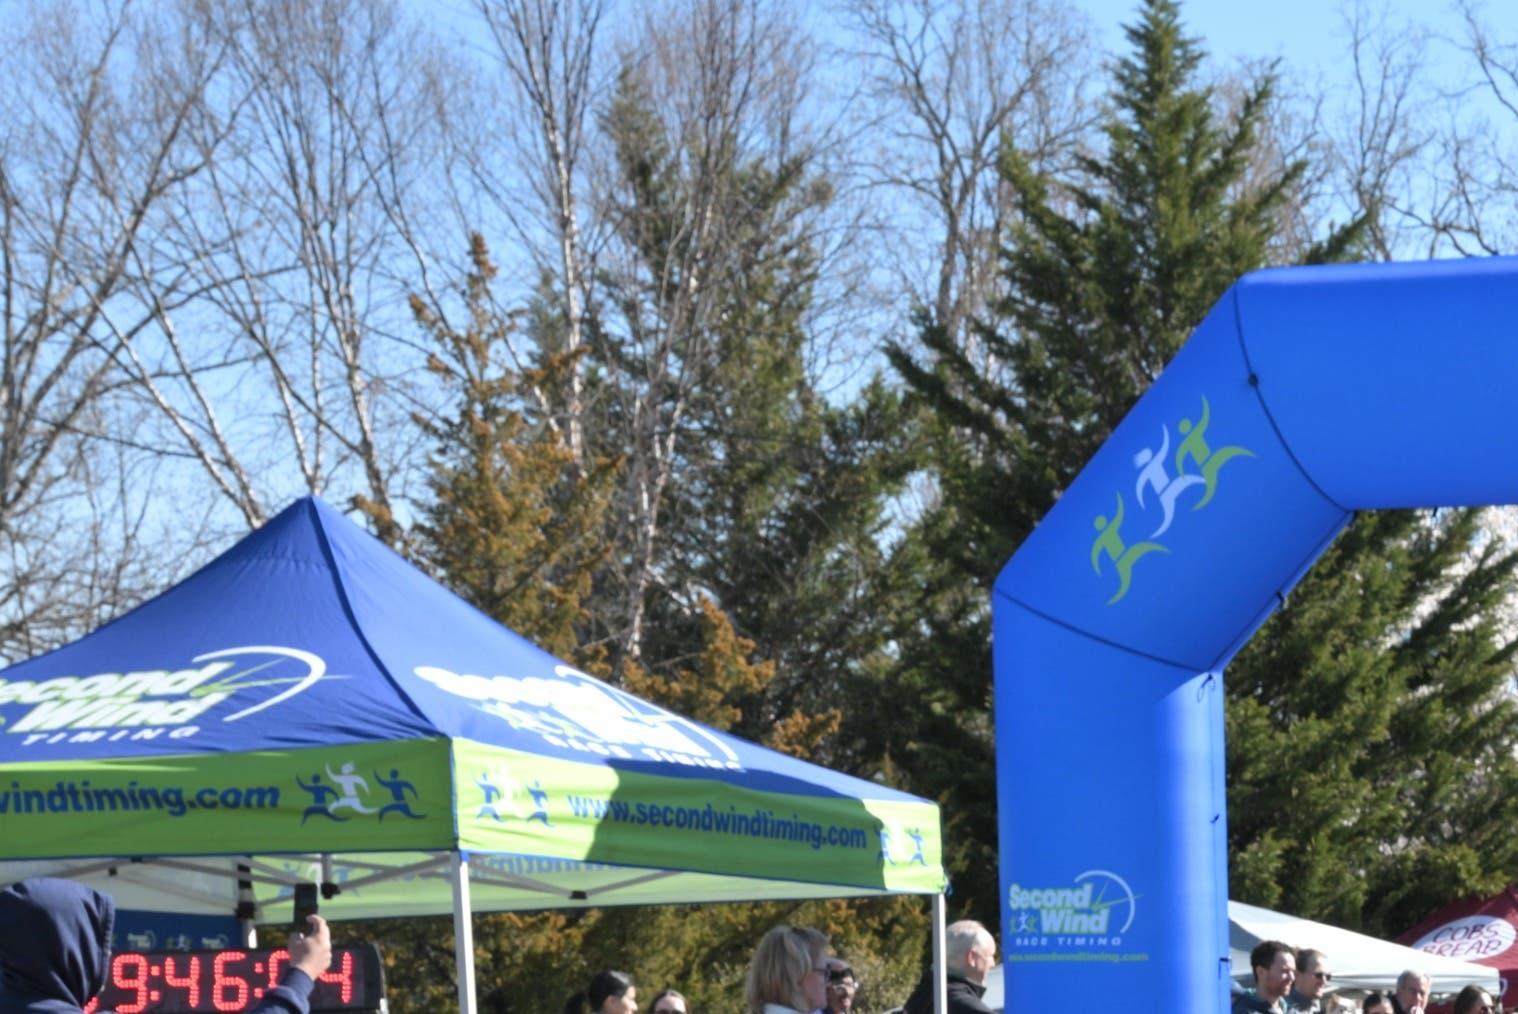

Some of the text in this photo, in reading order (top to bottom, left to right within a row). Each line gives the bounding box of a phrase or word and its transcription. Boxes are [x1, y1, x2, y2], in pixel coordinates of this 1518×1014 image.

[0, 661, 235, 704] econd
[7, 690, 235, 733] Wind
[22, 725, 201, 746] TIMING
[1009, 882, 1094, 911] Second
[1040, 908, 1111, 935] Wind
[1432, 923, 1502, 943] COBS
[1057, 936, 1122, 946] TIMING
